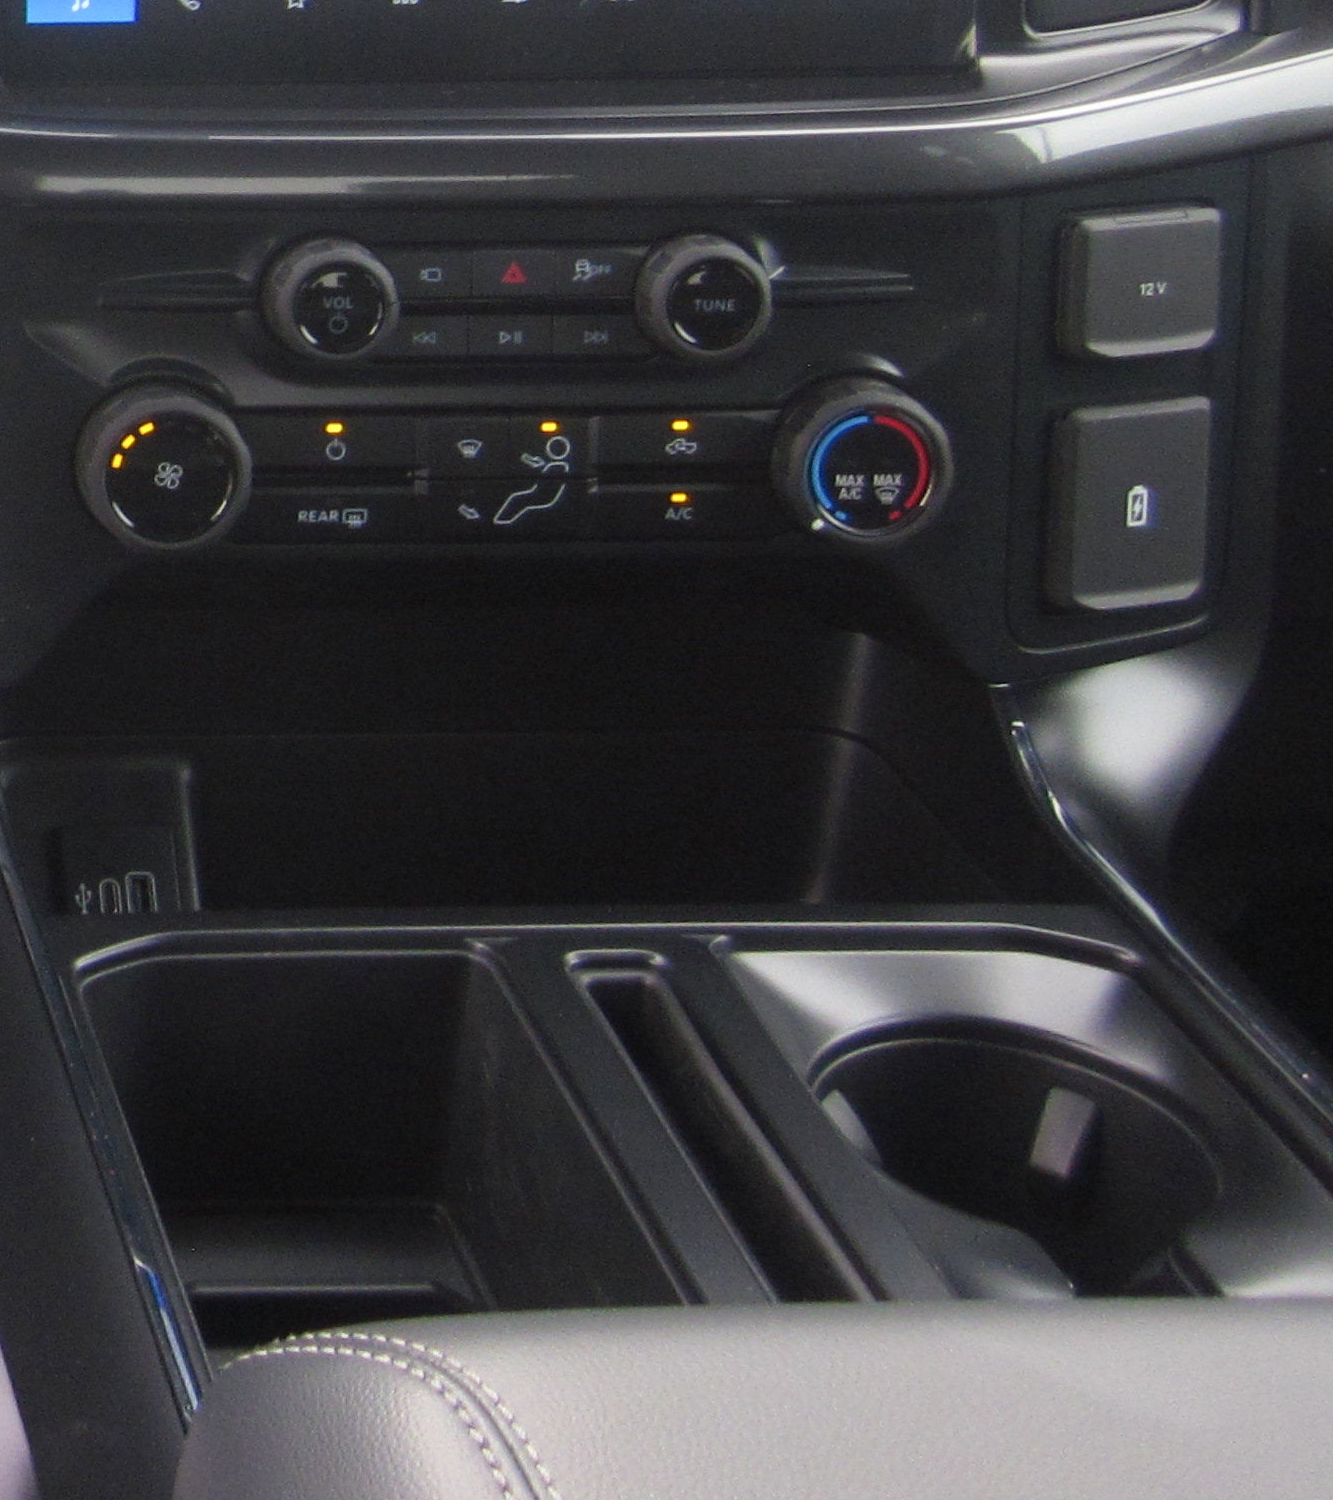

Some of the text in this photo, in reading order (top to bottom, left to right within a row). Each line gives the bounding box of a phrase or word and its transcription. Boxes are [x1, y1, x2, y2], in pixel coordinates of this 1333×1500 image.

[323, 296, 353, 310] VOL
[694, 300, 736, 313] TUNE
[835, 474, 865, 486] MAX
[872, 473, 903, 486] MAX
[838, 487, 862, 501] A/C
[298, 510, 340, 524] REAR
[664, 507, 693, 521] A/C
